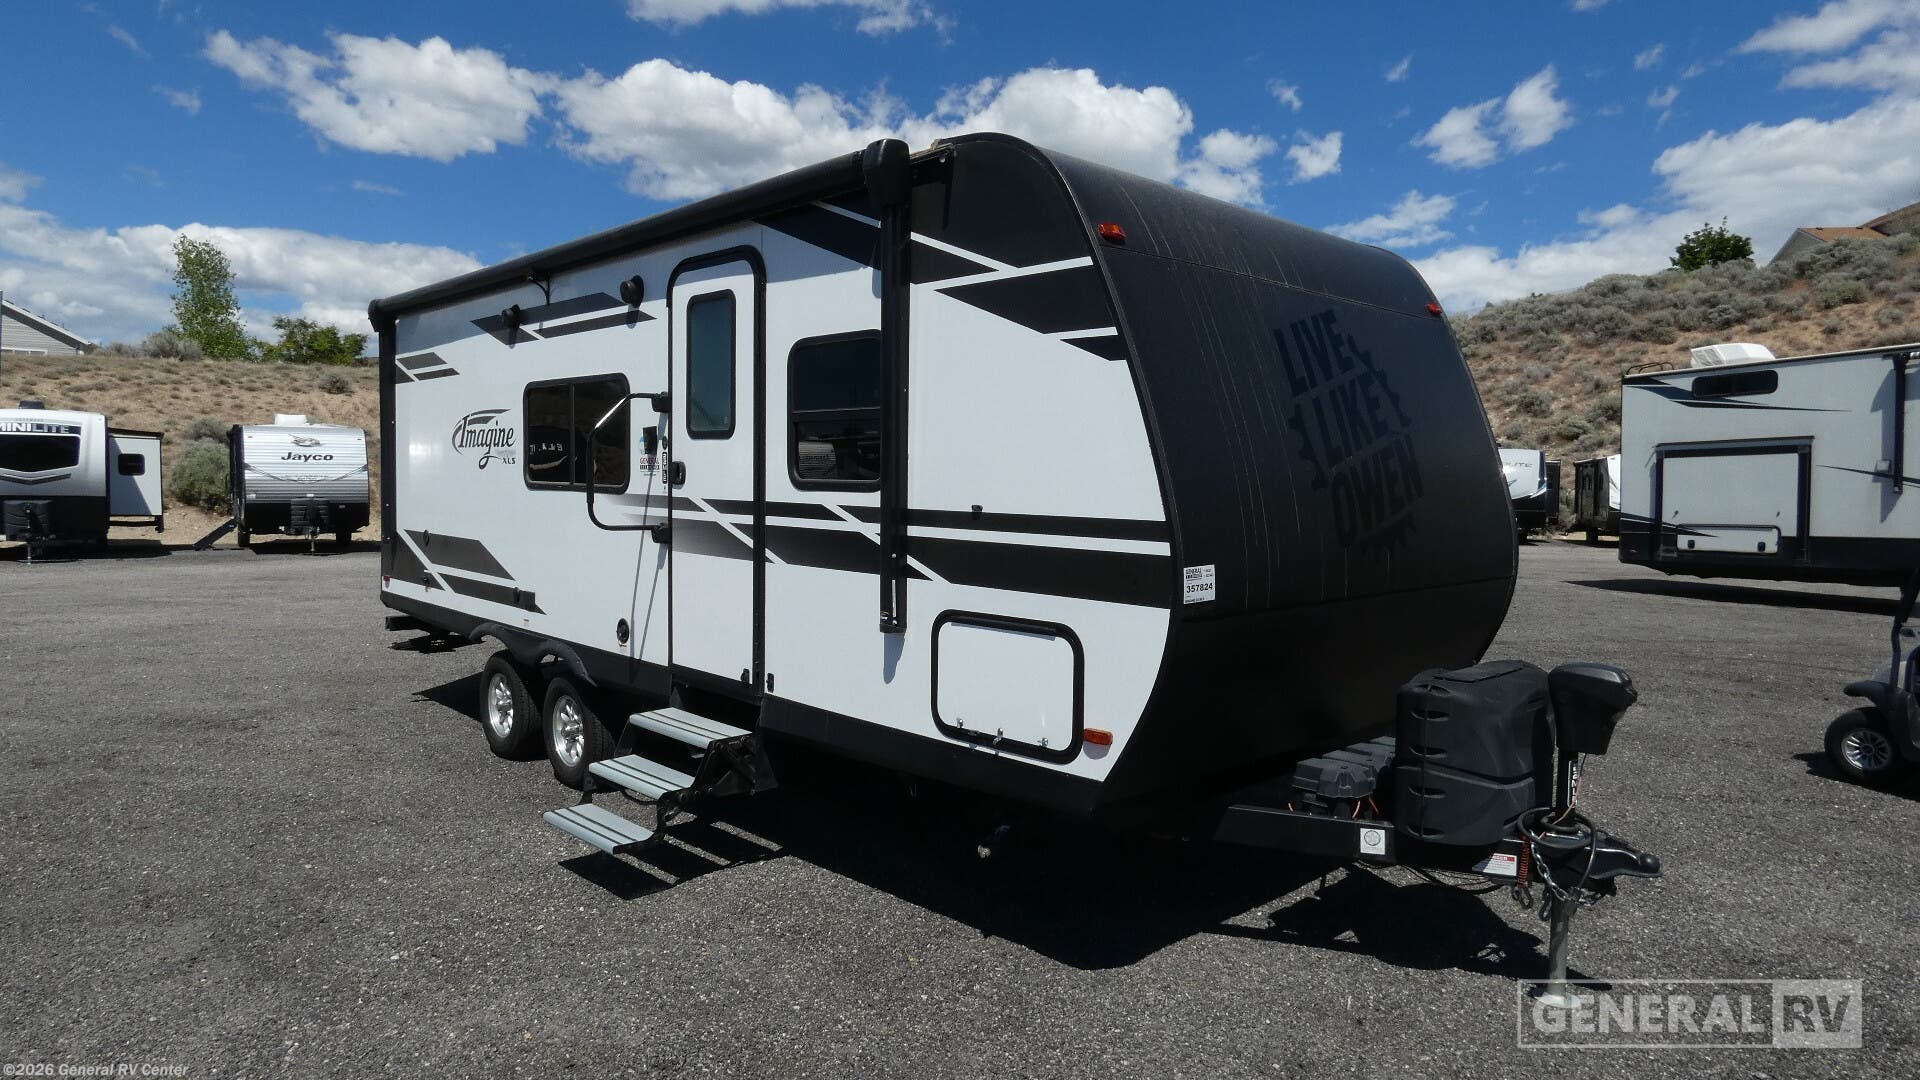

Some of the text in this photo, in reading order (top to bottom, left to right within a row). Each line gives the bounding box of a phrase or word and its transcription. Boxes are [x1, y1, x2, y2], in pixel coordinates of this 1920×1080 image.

[1274, 309, 1354, 397] LIVE
[458, 415, 516, 470] Imagine
[1312, 370, 1389, 468] LIKE
[281, 451, 334, 462] Jayco
[1332, 434, 1424, 548] OWEN
[1186, 583, 1213, 593] 357824
